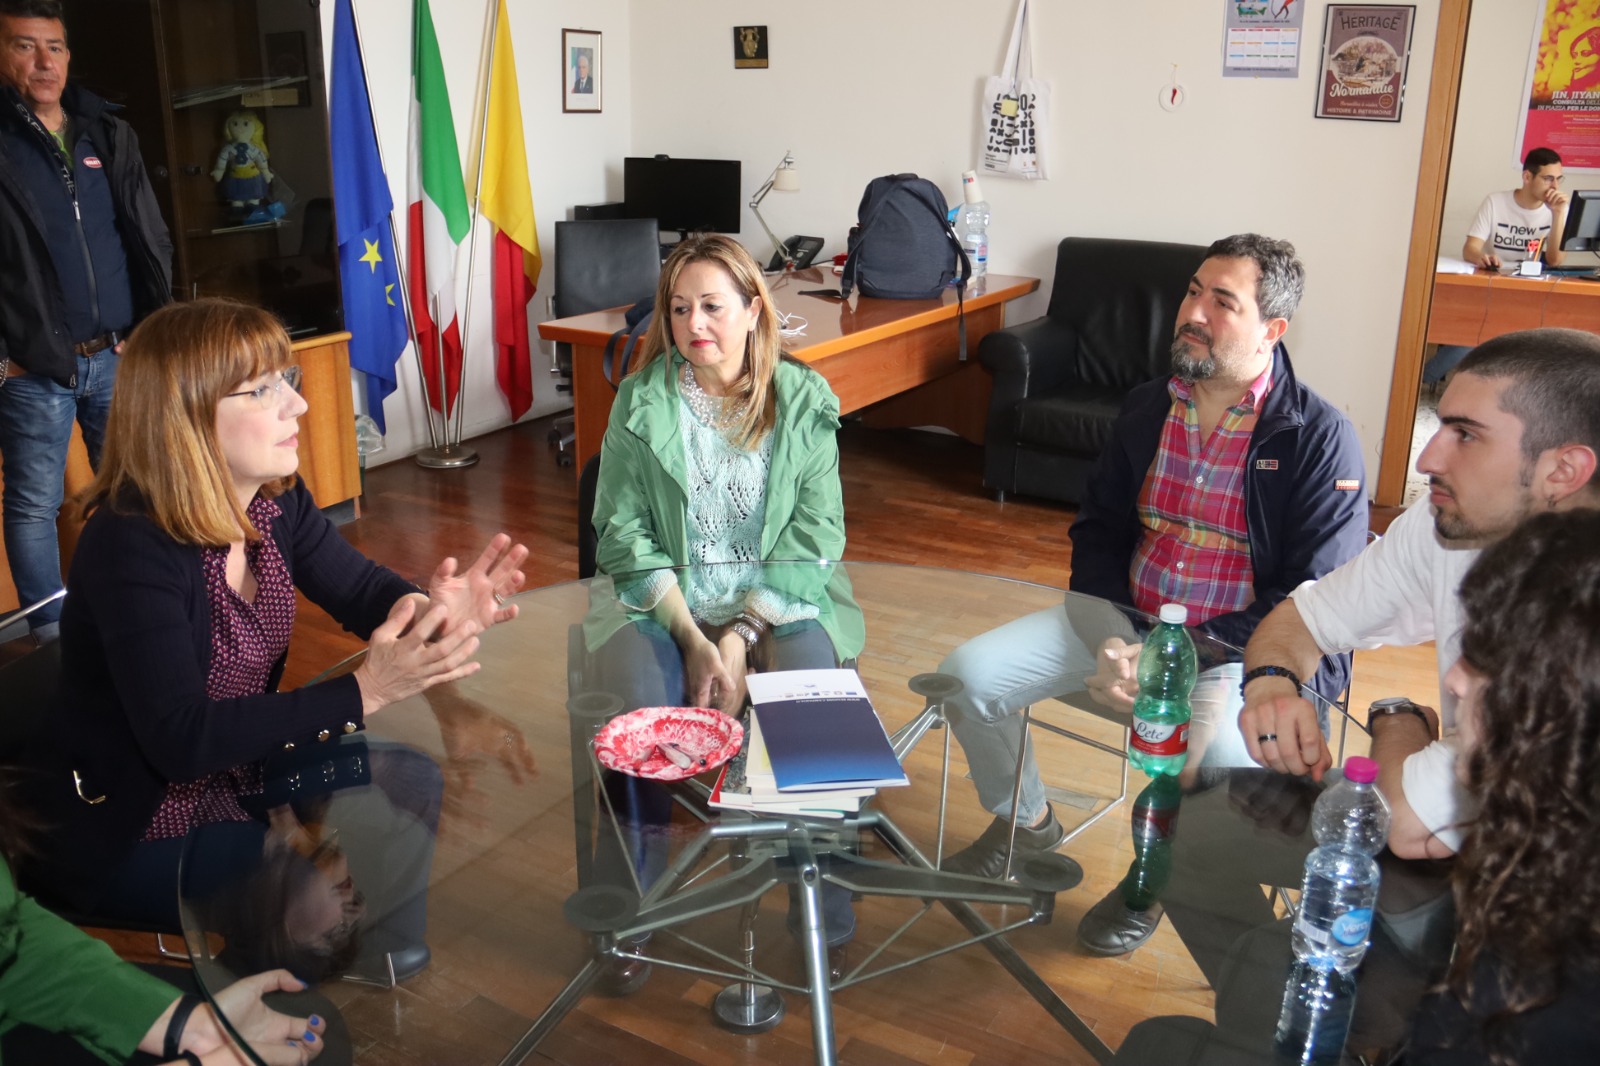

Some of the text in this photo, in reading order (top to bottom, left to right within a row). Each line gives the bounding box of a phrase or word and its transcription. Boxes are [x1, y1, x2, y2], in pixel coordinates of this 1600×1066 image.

[1329, 83, 1394, 97] Normandie
[1551, 91, 1569, 100] JIN,
[1509, 225, 1537, 236] new
